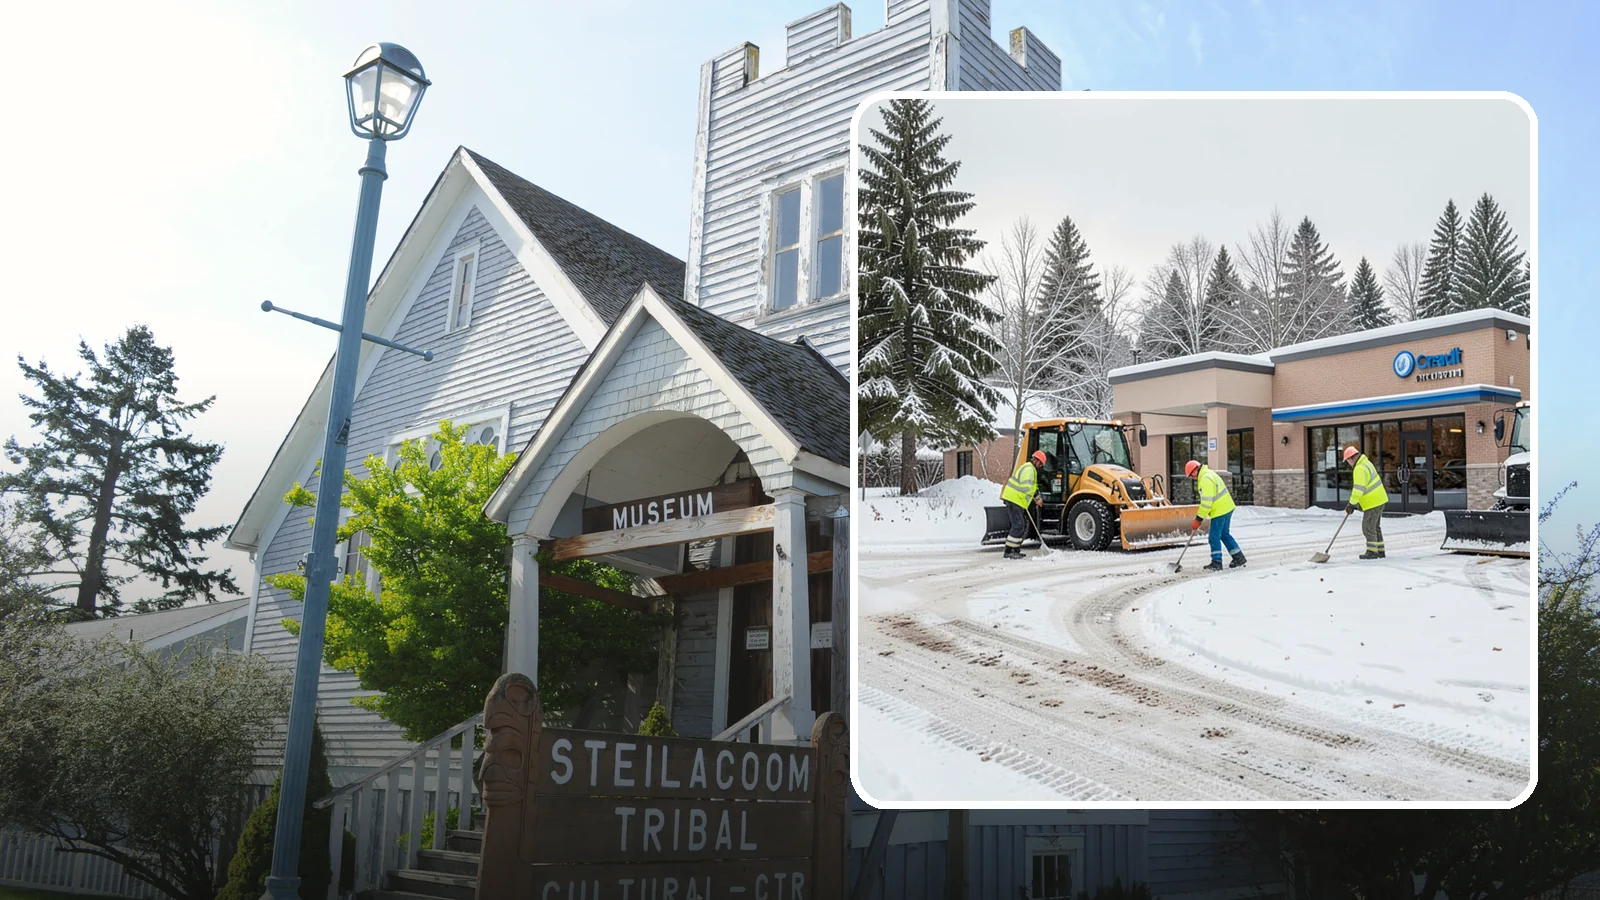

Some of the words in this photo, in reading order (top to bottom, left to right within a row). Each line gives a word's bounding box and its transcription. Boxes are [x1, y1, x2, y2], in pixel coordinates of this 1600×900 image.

[613, 491, 713, 530] MUSEUM
[550, 738, 810, 793] STEILACOOM
[615, 806, 757, 851] TRIBAL
